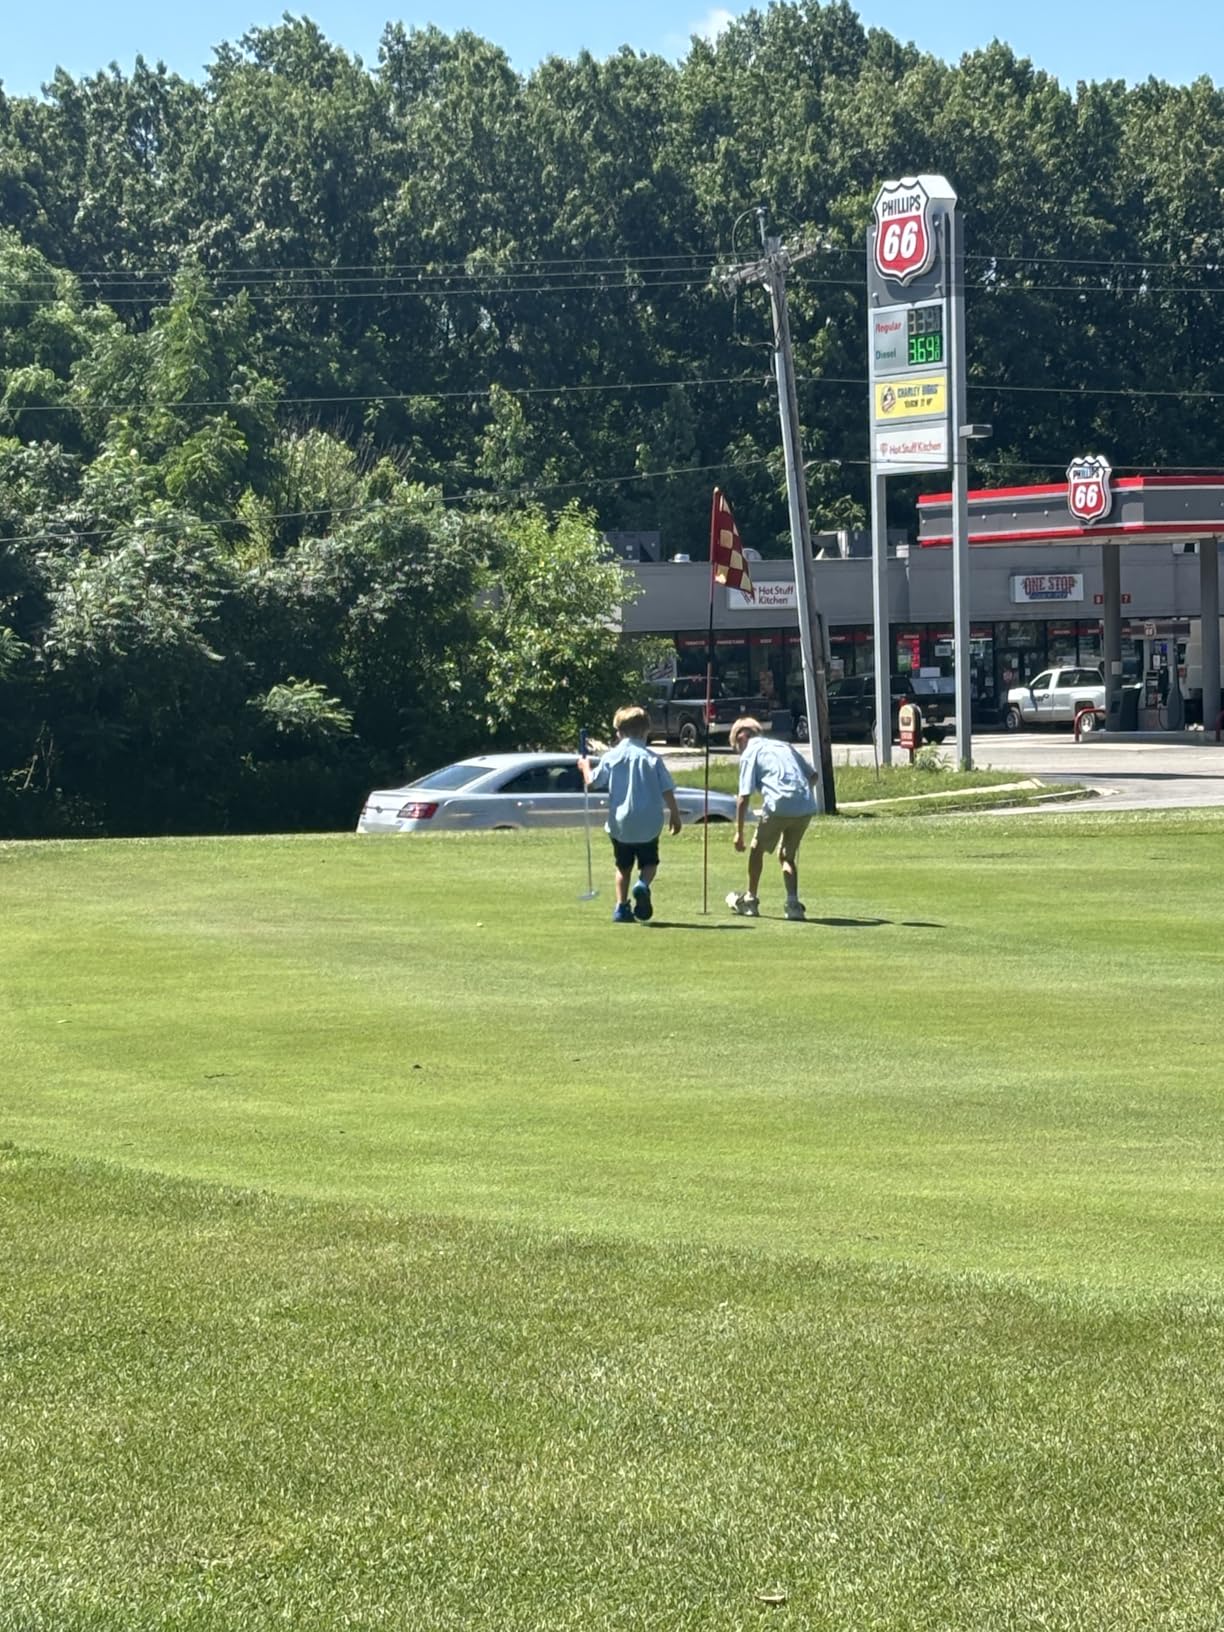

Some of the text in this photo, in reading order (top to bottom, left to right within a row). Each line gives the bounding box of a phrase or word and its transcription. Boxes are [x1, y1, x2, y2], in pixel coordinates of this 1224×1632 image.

[882, 194, 921, 217] PHILLIPS
[883, 221, 918, 261] 66
[875, 321, 902, 334] Regular
[876, 348, 897, 360] Diesel
[889, 440, 941, 455] Hot Stuff Kitchen
[1075, 484, 1098, 509] 66
[759, 585, 794, 595] Hot Stuff
[1024, 576, 1075, 595] ONE STOP
[758, 596, 788, 604] Kitchen
